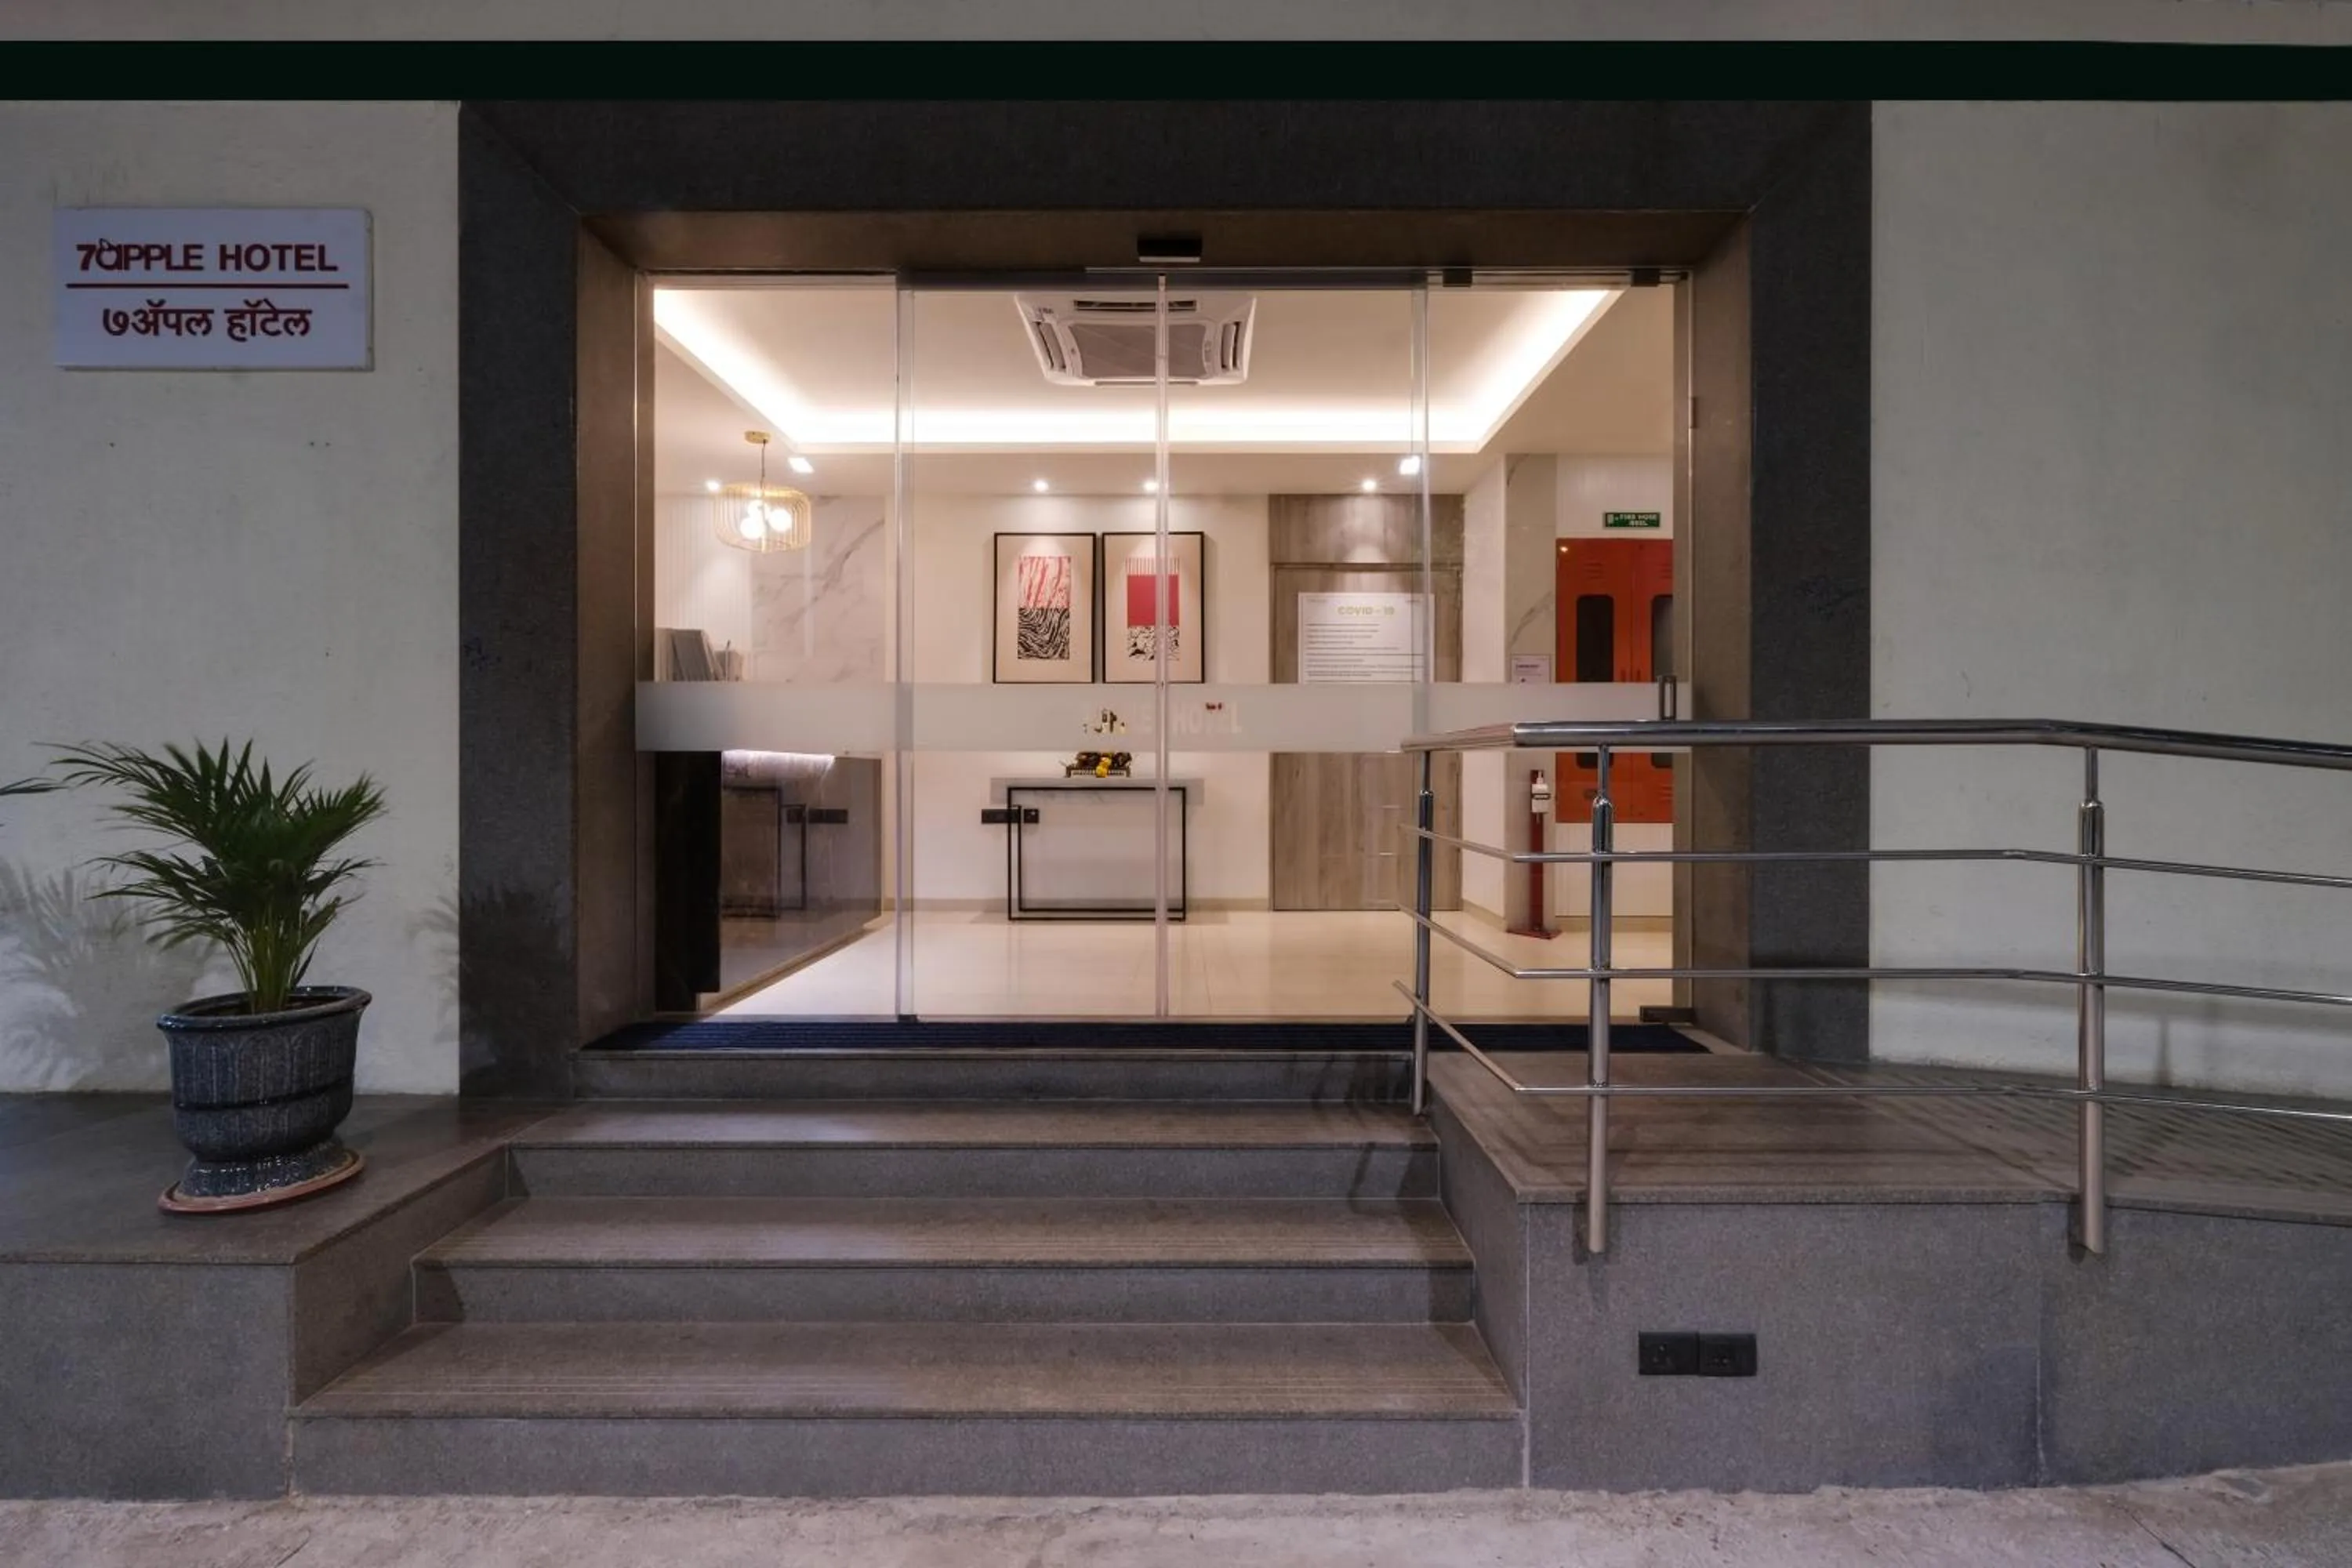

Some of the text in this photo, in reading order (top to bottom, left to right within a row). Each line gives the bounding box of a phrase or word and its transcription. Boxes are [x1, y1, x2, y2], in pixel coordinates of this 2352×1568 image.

[219, 244, 339, 272] HOTEL
[223, 298, 314, 343] हॉटेल
[1337, 606, 1374, 615] COVID
